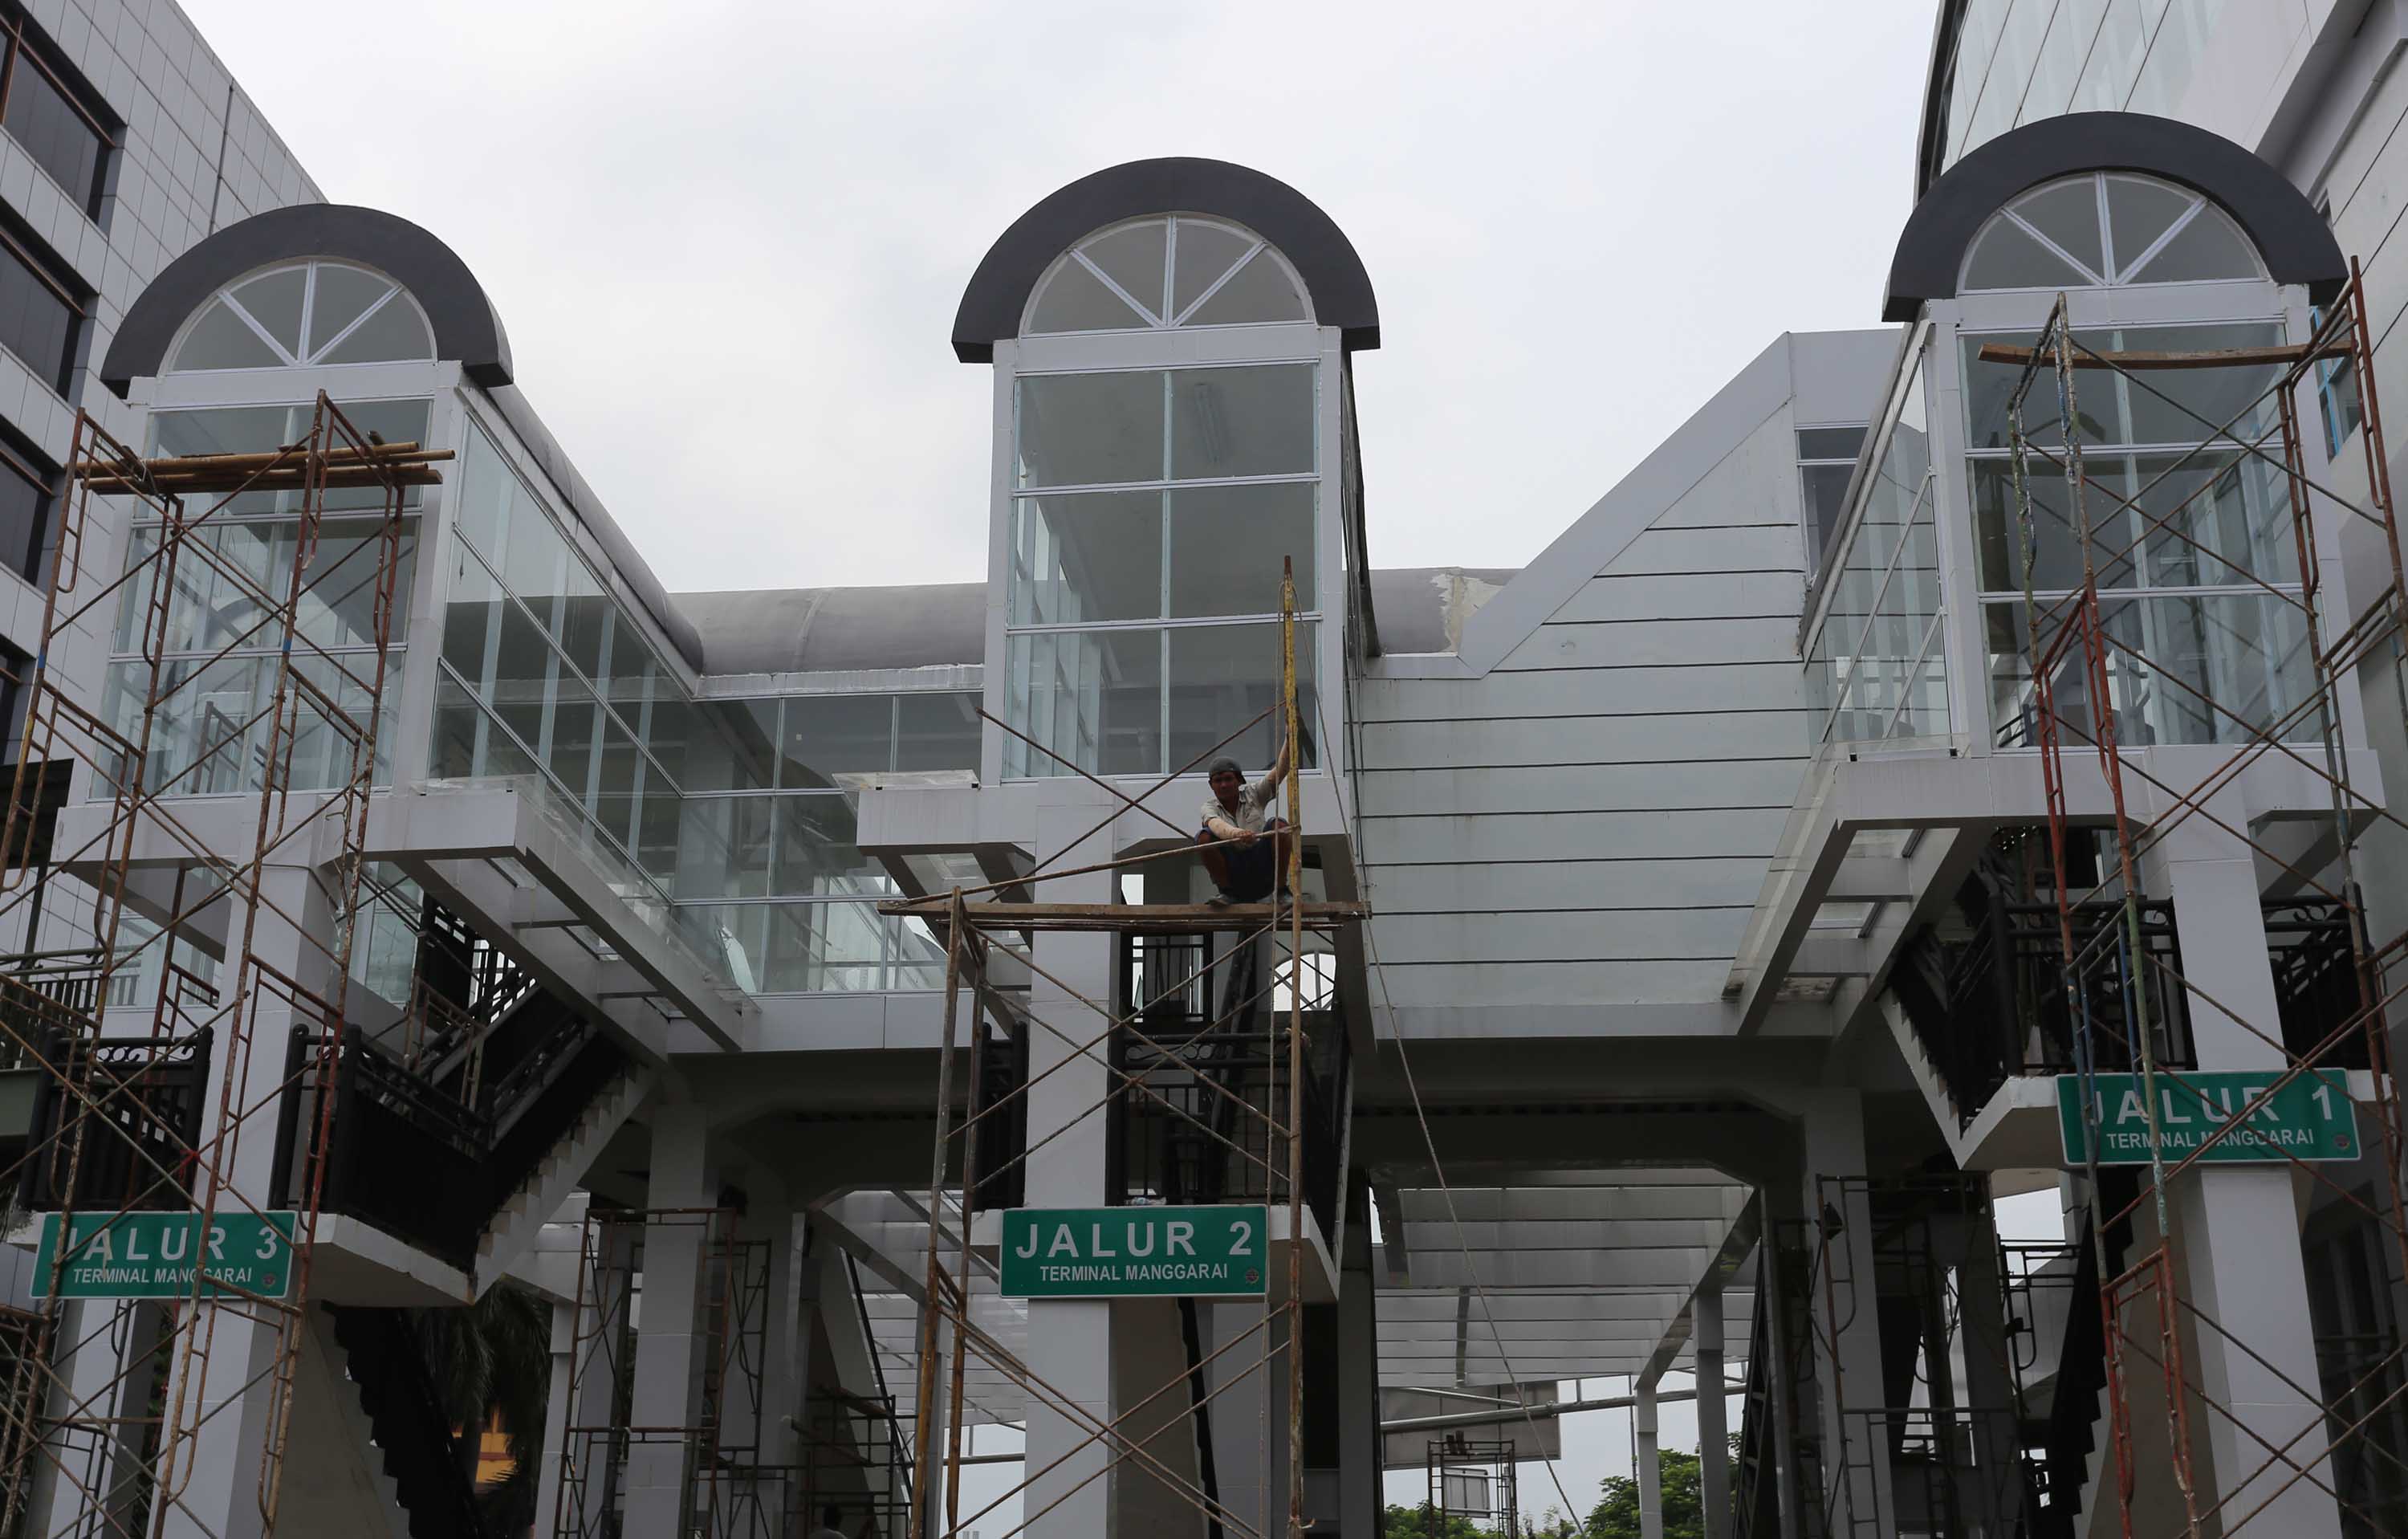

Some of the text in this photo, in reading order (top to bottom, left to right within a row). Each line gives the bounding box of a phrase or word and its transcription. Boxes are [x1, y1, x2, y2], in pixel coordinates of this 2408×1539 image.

[2311, 1084, 2333, 1121] 1
[2105, 1131, 2197, 1149] TERMNAL
[255, 1225, 279, 1260] 3
[1015, 1219, 1253, 1260] JALUR 2
[73, 1267, 150, 1284] TERMINAL
[1039, 1263, 1228, 1282] TERMINAL MANGGARAI
